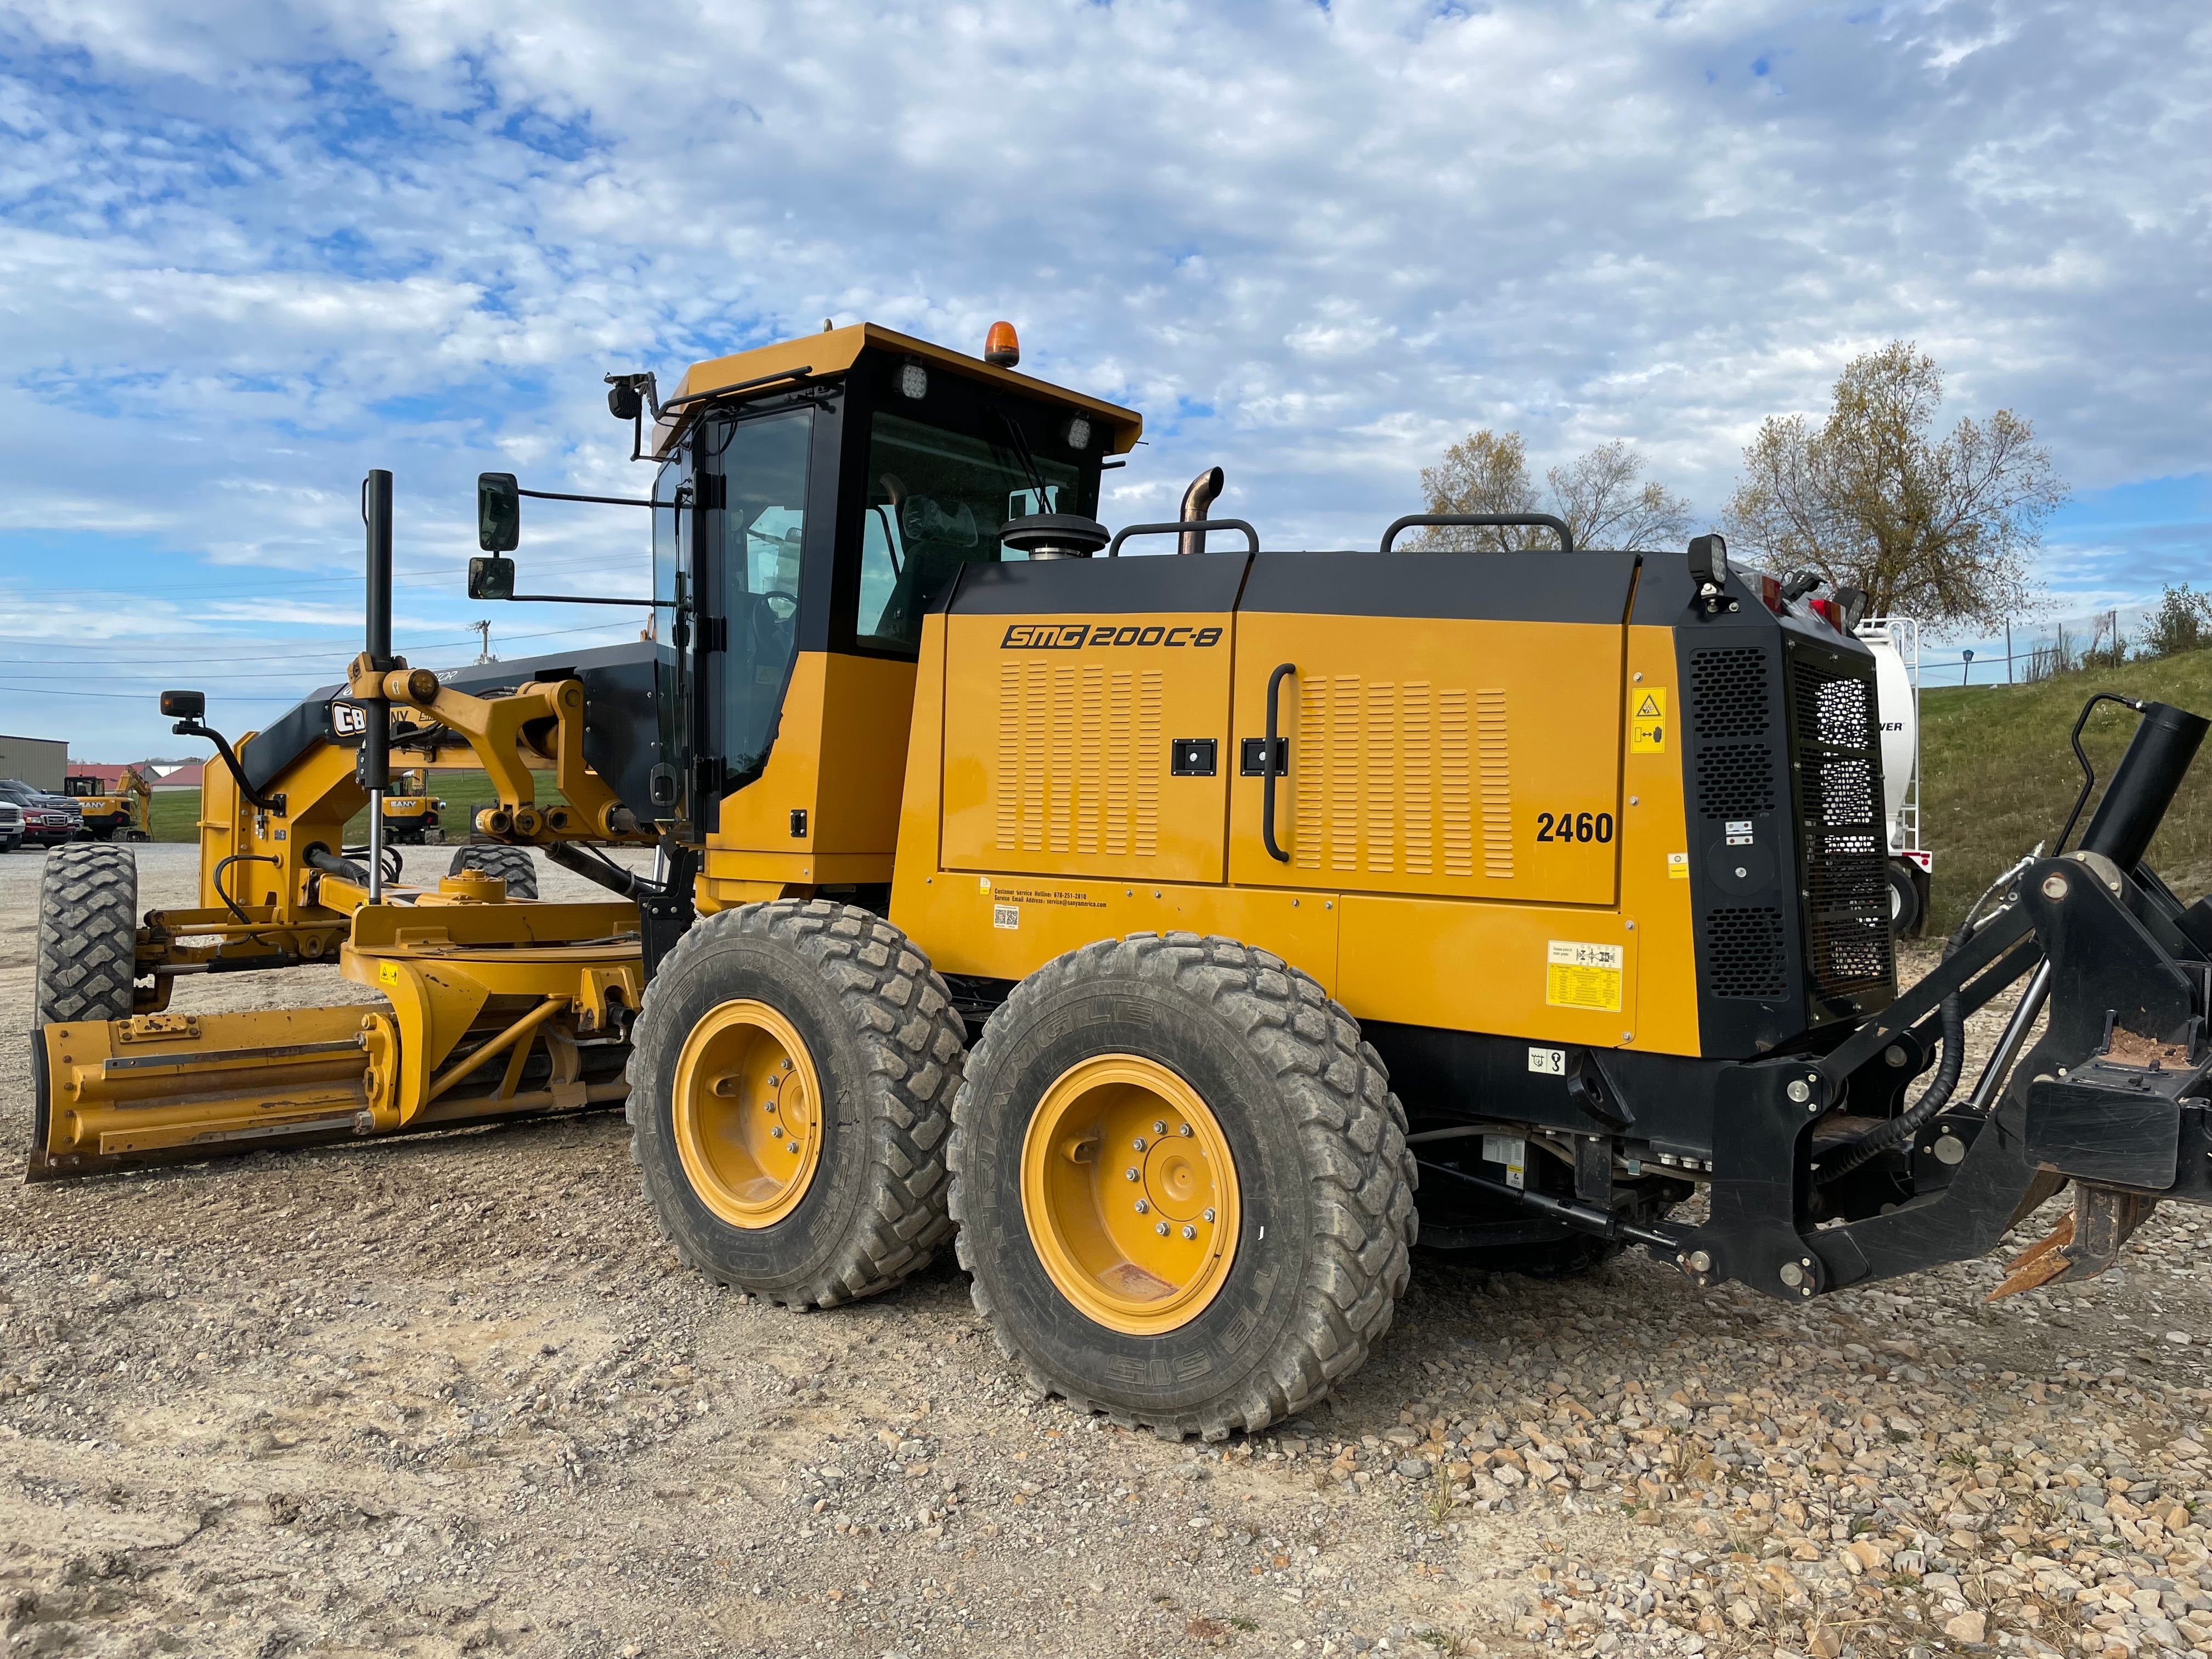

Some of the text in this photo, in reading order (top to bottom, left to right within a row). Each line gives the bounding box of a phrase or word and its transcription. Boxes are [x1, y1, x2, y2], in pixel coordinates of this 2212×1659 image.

[1537, 812, 1613, 843] 2460
[1047, 899, 1107, 908] service@sanyamerica.com
[1054, 891, 1087, 900] 678-251-2810
[979, 1000, 1154, 1264] TRIANGLE
